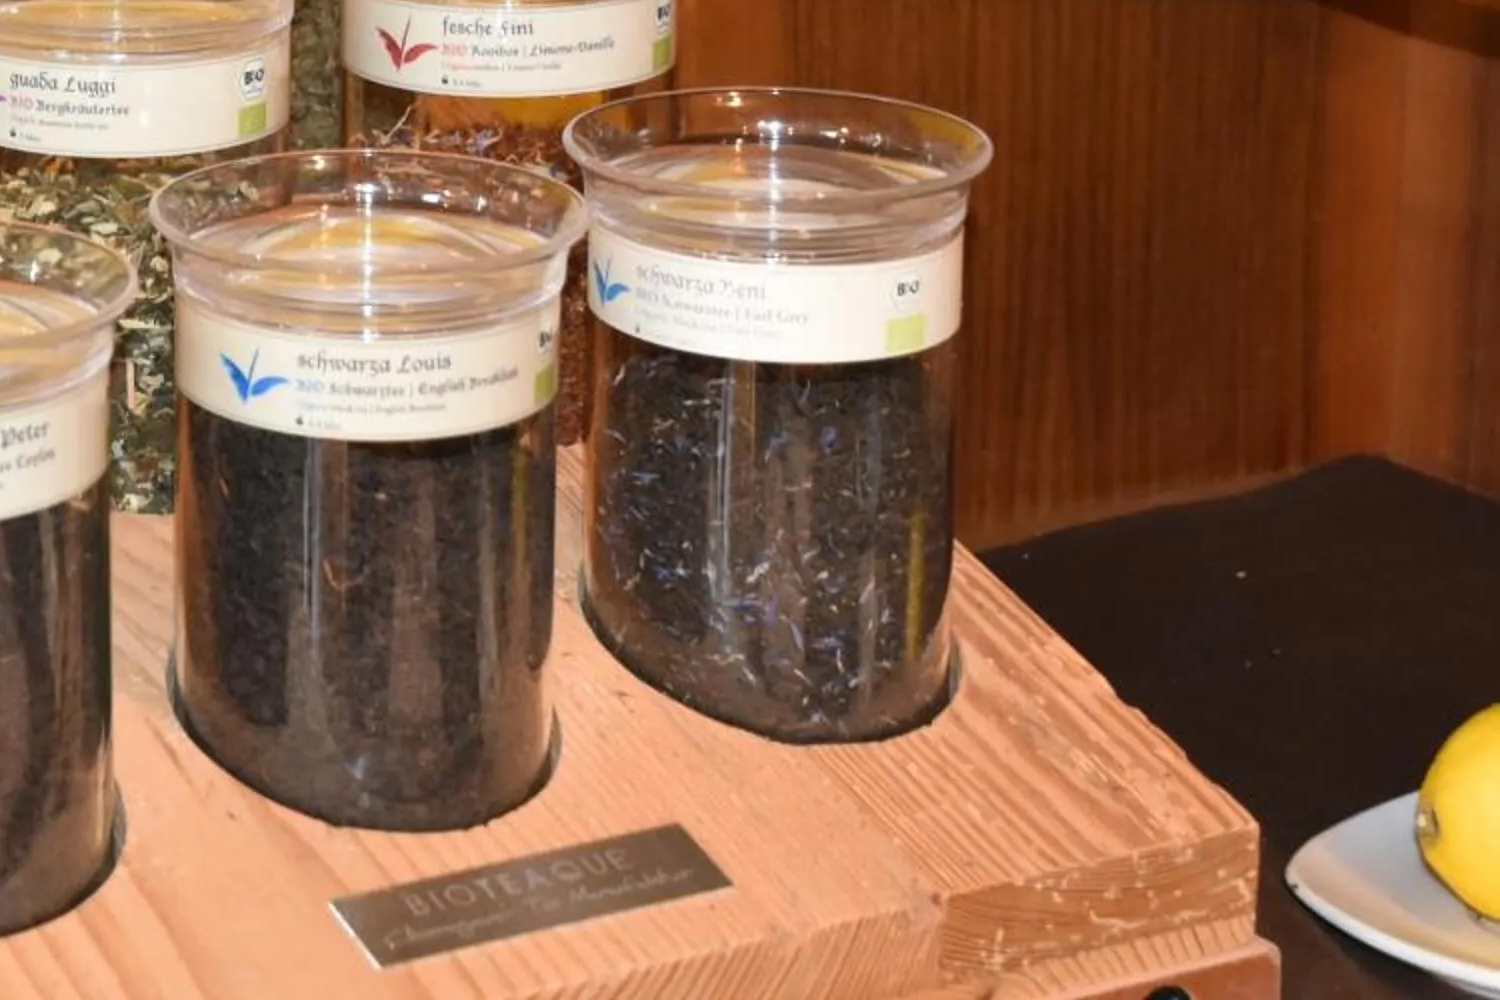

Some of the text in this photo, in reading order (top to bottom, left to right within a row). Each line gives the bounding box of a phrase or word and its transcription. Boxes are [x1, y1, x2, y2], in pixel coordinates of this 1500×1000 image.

[63, 75, 116, 98] Luggi
[243, 67, 266, 86] BIO
[10, 95, 34, 110] BIO
[896, 279, 920, 297] BIO
[396, 352, 452, 374] Louis
[0, 421, 49, 451] Peter
[403, 848, 636, 918] BIOTEAQUE
